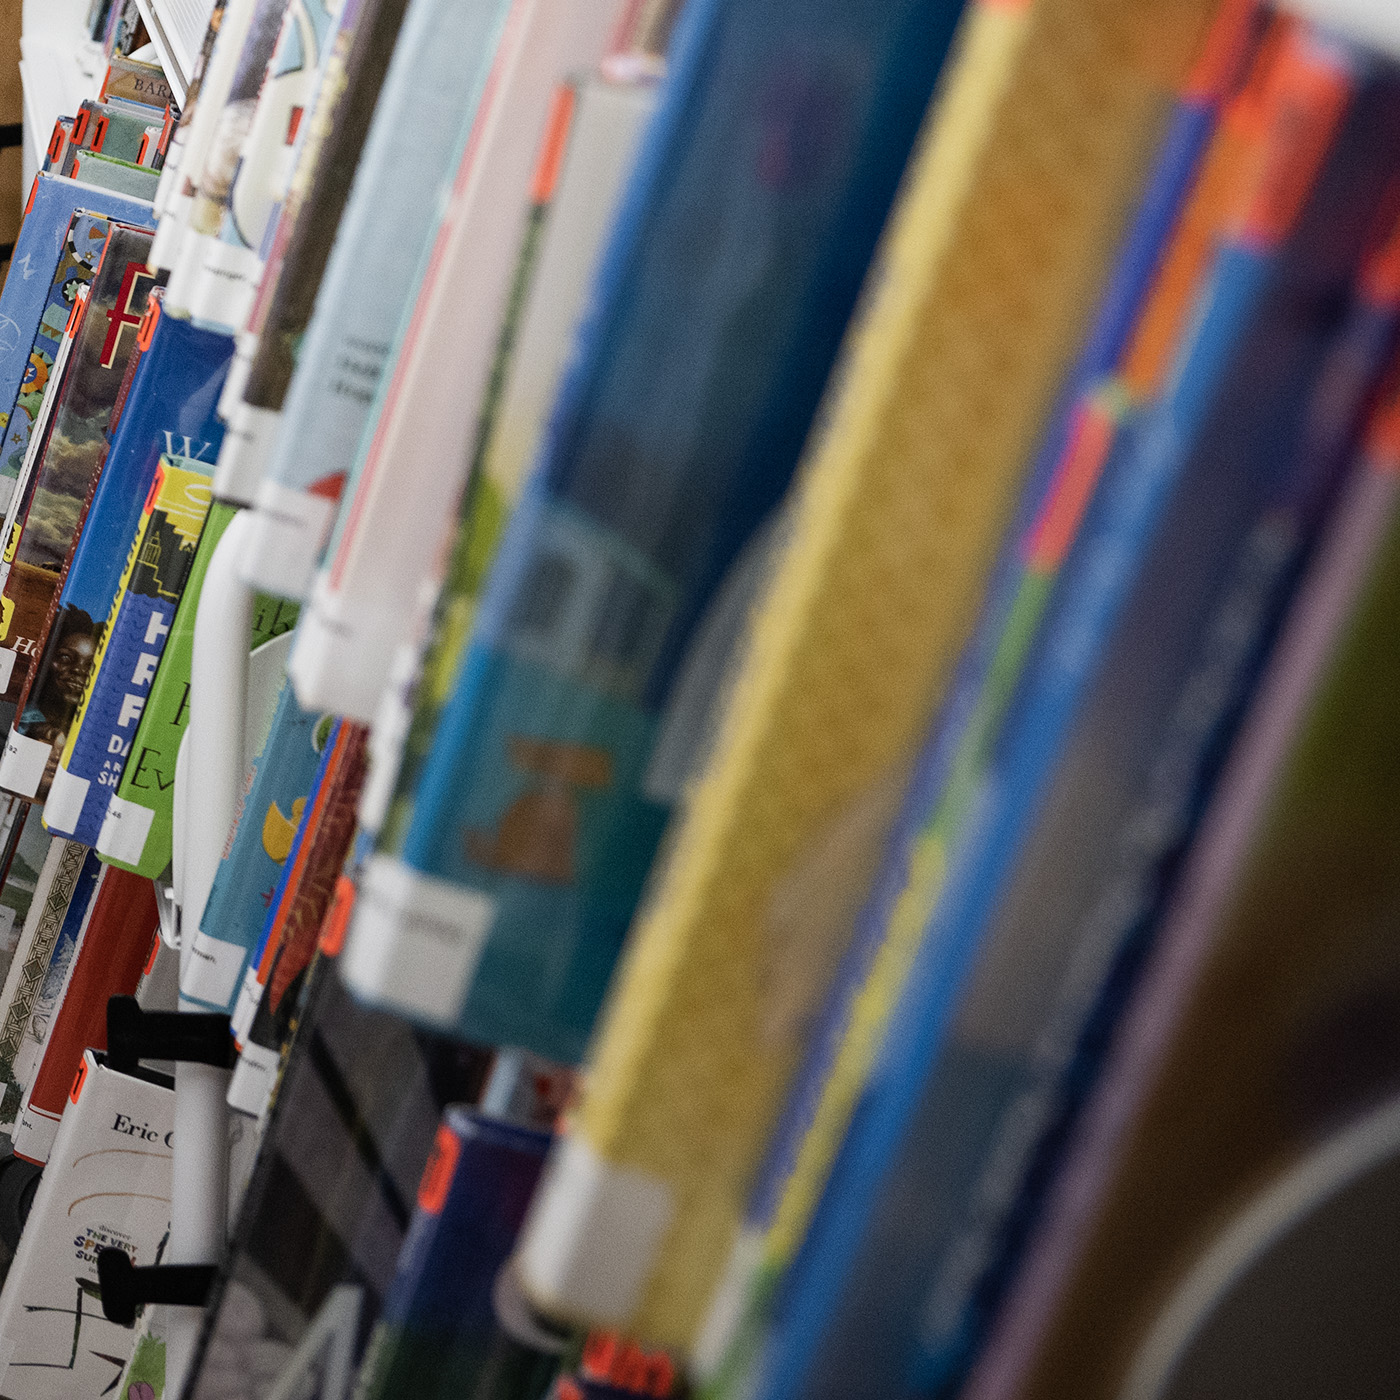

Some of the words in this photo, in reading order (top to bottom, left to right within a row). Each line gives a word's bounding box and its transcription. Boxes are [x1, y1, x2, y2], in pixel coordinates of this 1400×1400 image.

[110, 1112, 160, 1144] Eric
[85, 1227, 102, 1243] THE
[110, 1236, 138, 1254] VERY
